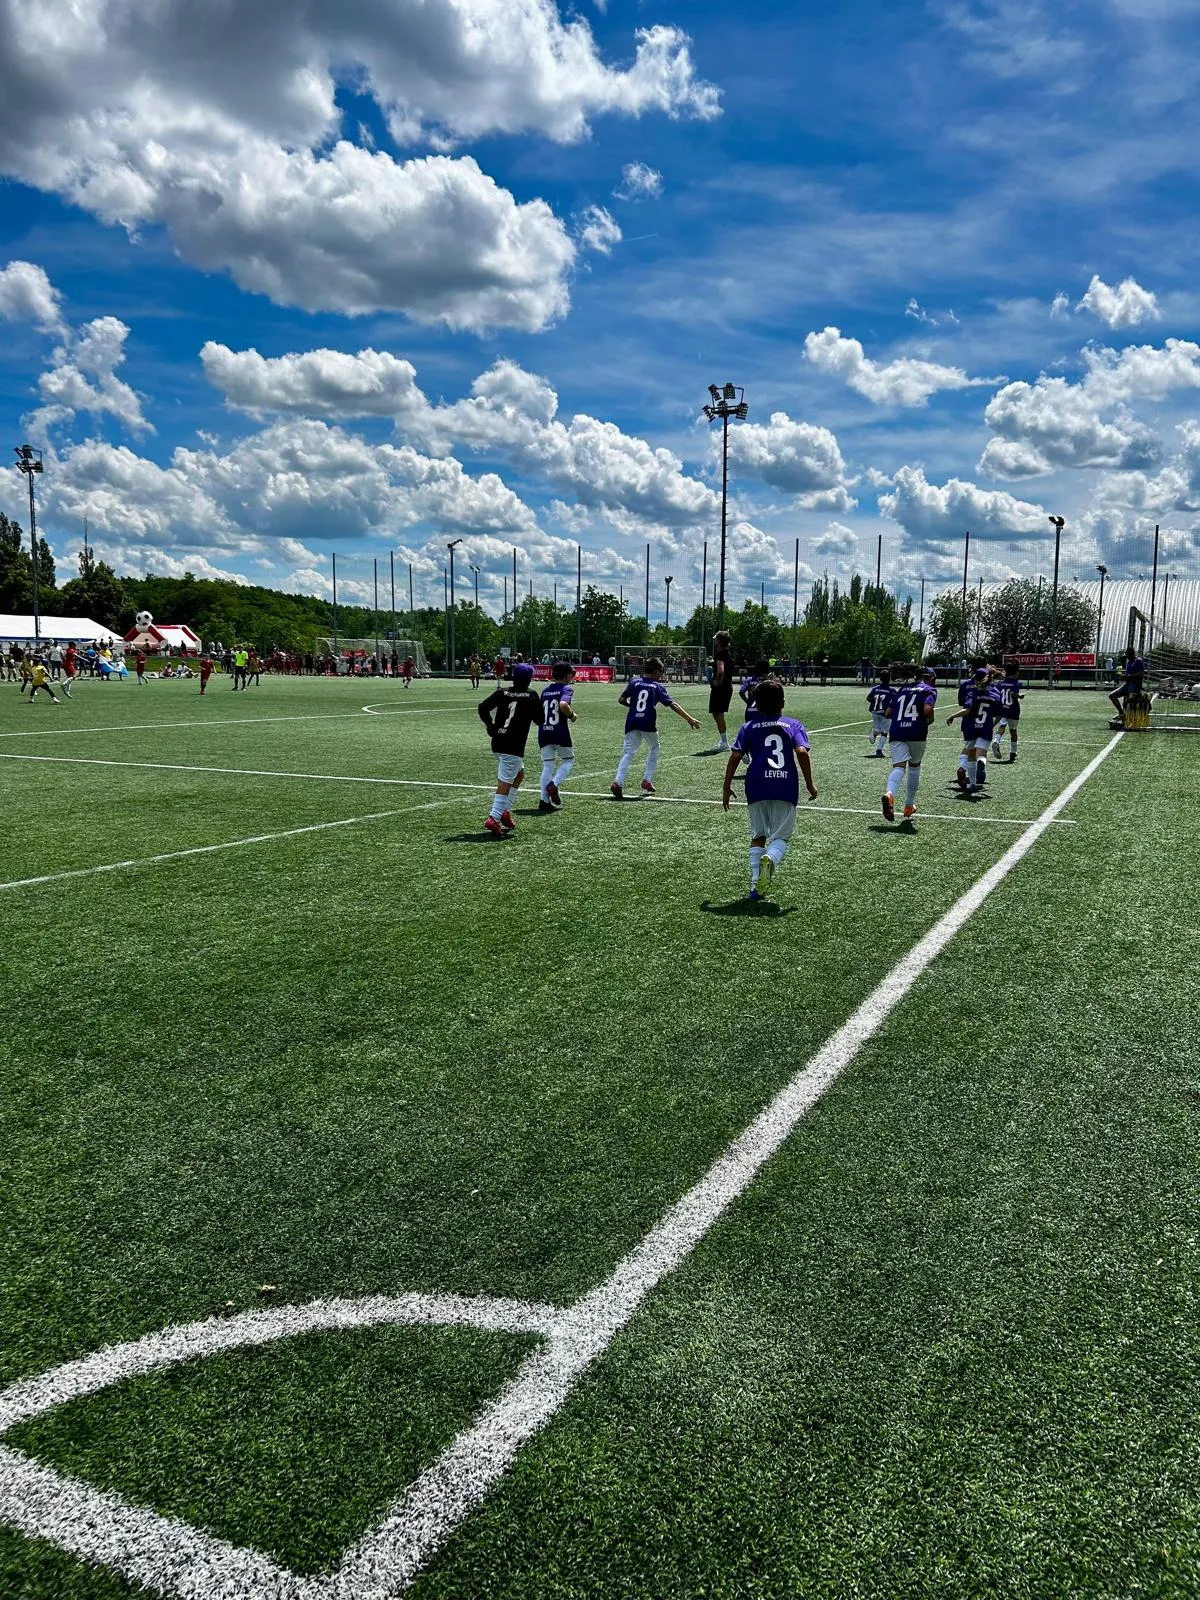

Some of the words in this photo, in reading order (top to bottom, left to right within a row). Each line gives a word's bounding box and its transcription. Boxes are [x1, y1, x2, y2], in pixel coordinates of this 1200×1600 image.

[636, 690, 648, 712] 8
[874, 694, 887, 711] 11
[1001, 688, 1014, 706] 10
[543, 699, 560, 726] 13
[897, 694, 919, 722] 14
[974, 703, 990, 724] 5
[765, 734, 785, 769] 3
[764, 770, 789, 779] LEVENT
